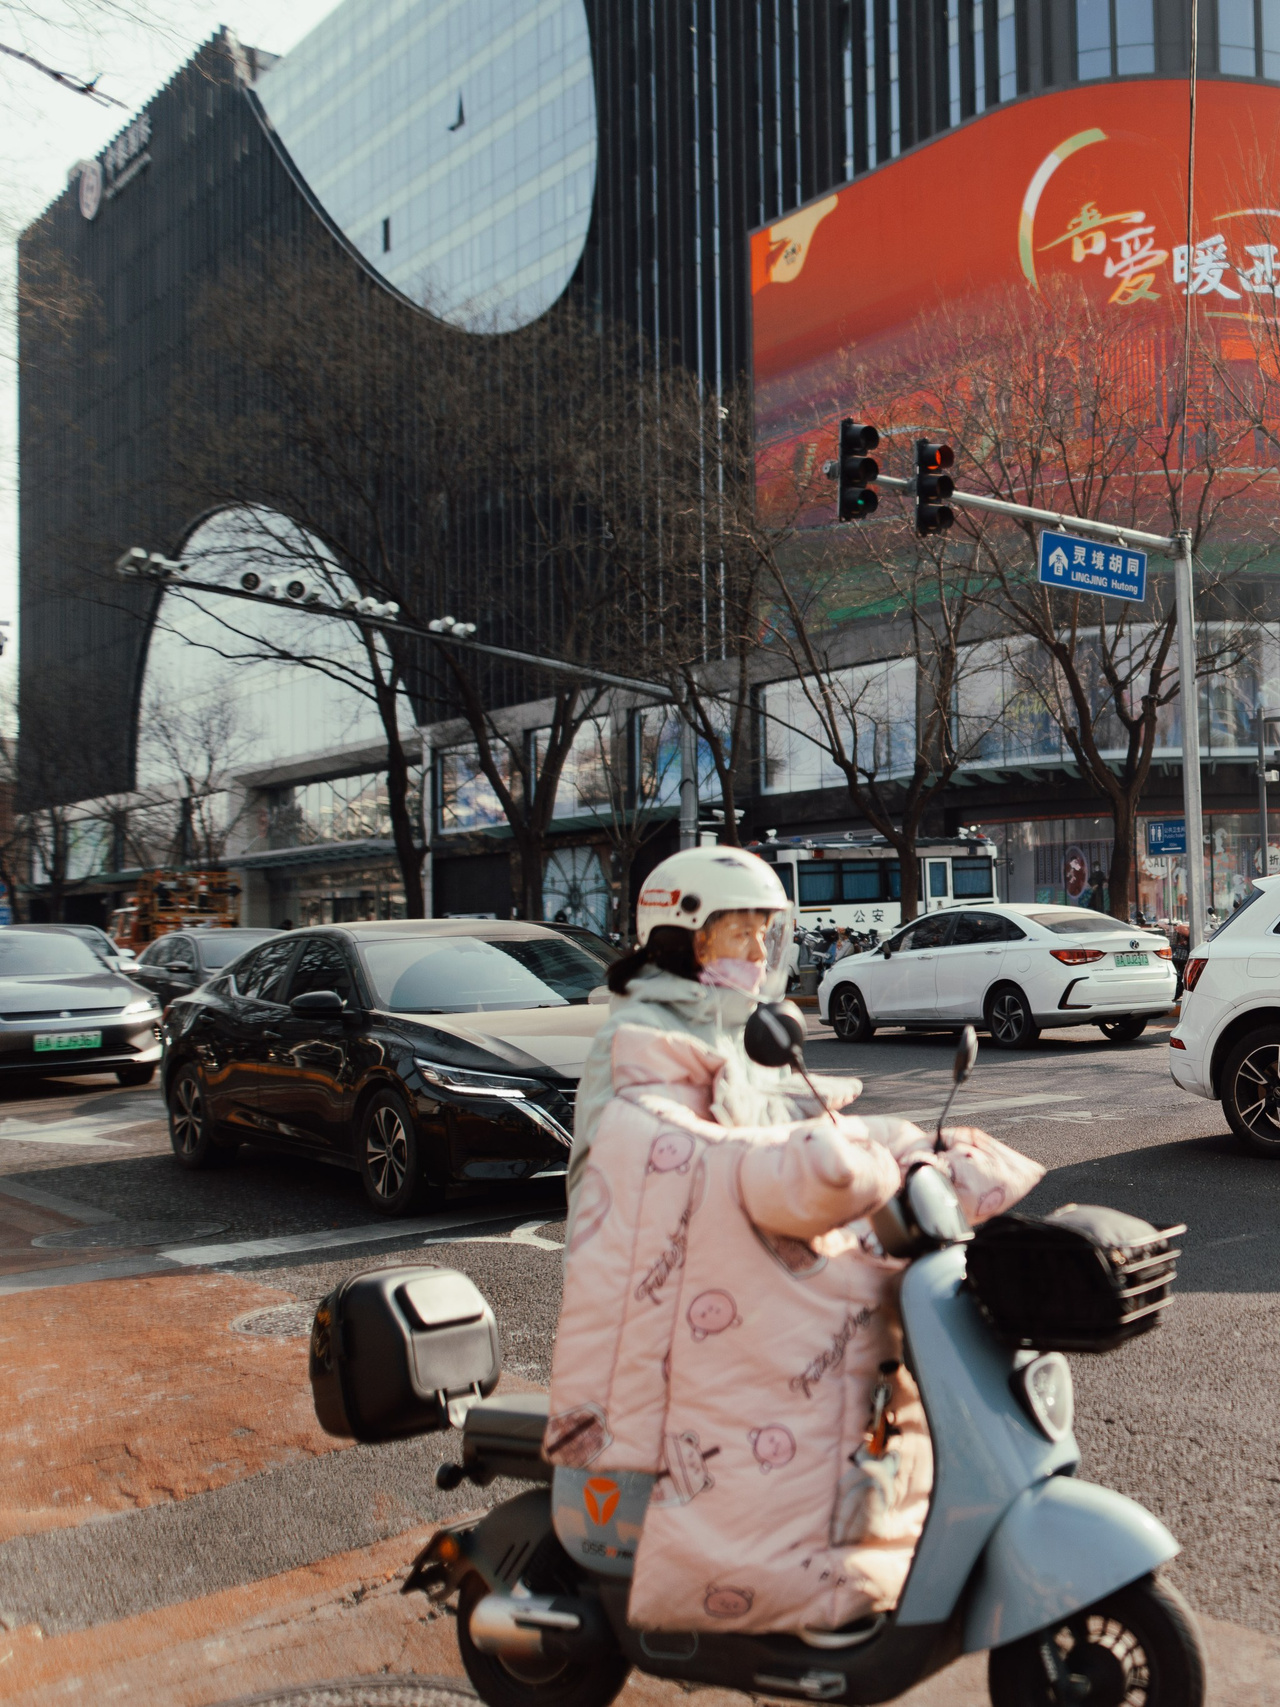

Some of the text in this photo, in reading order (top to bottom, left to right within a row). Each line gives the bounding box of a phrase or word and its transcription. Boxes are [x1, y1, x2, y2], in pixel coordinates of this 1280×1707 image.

[1072, 545, 1140, 577] 灵境胡同
[1071, 571, 1138, 595] LINGJING Hutong
[1148, 857, 1165, 868] SAL
[853, 908, 884, 923] 公安
